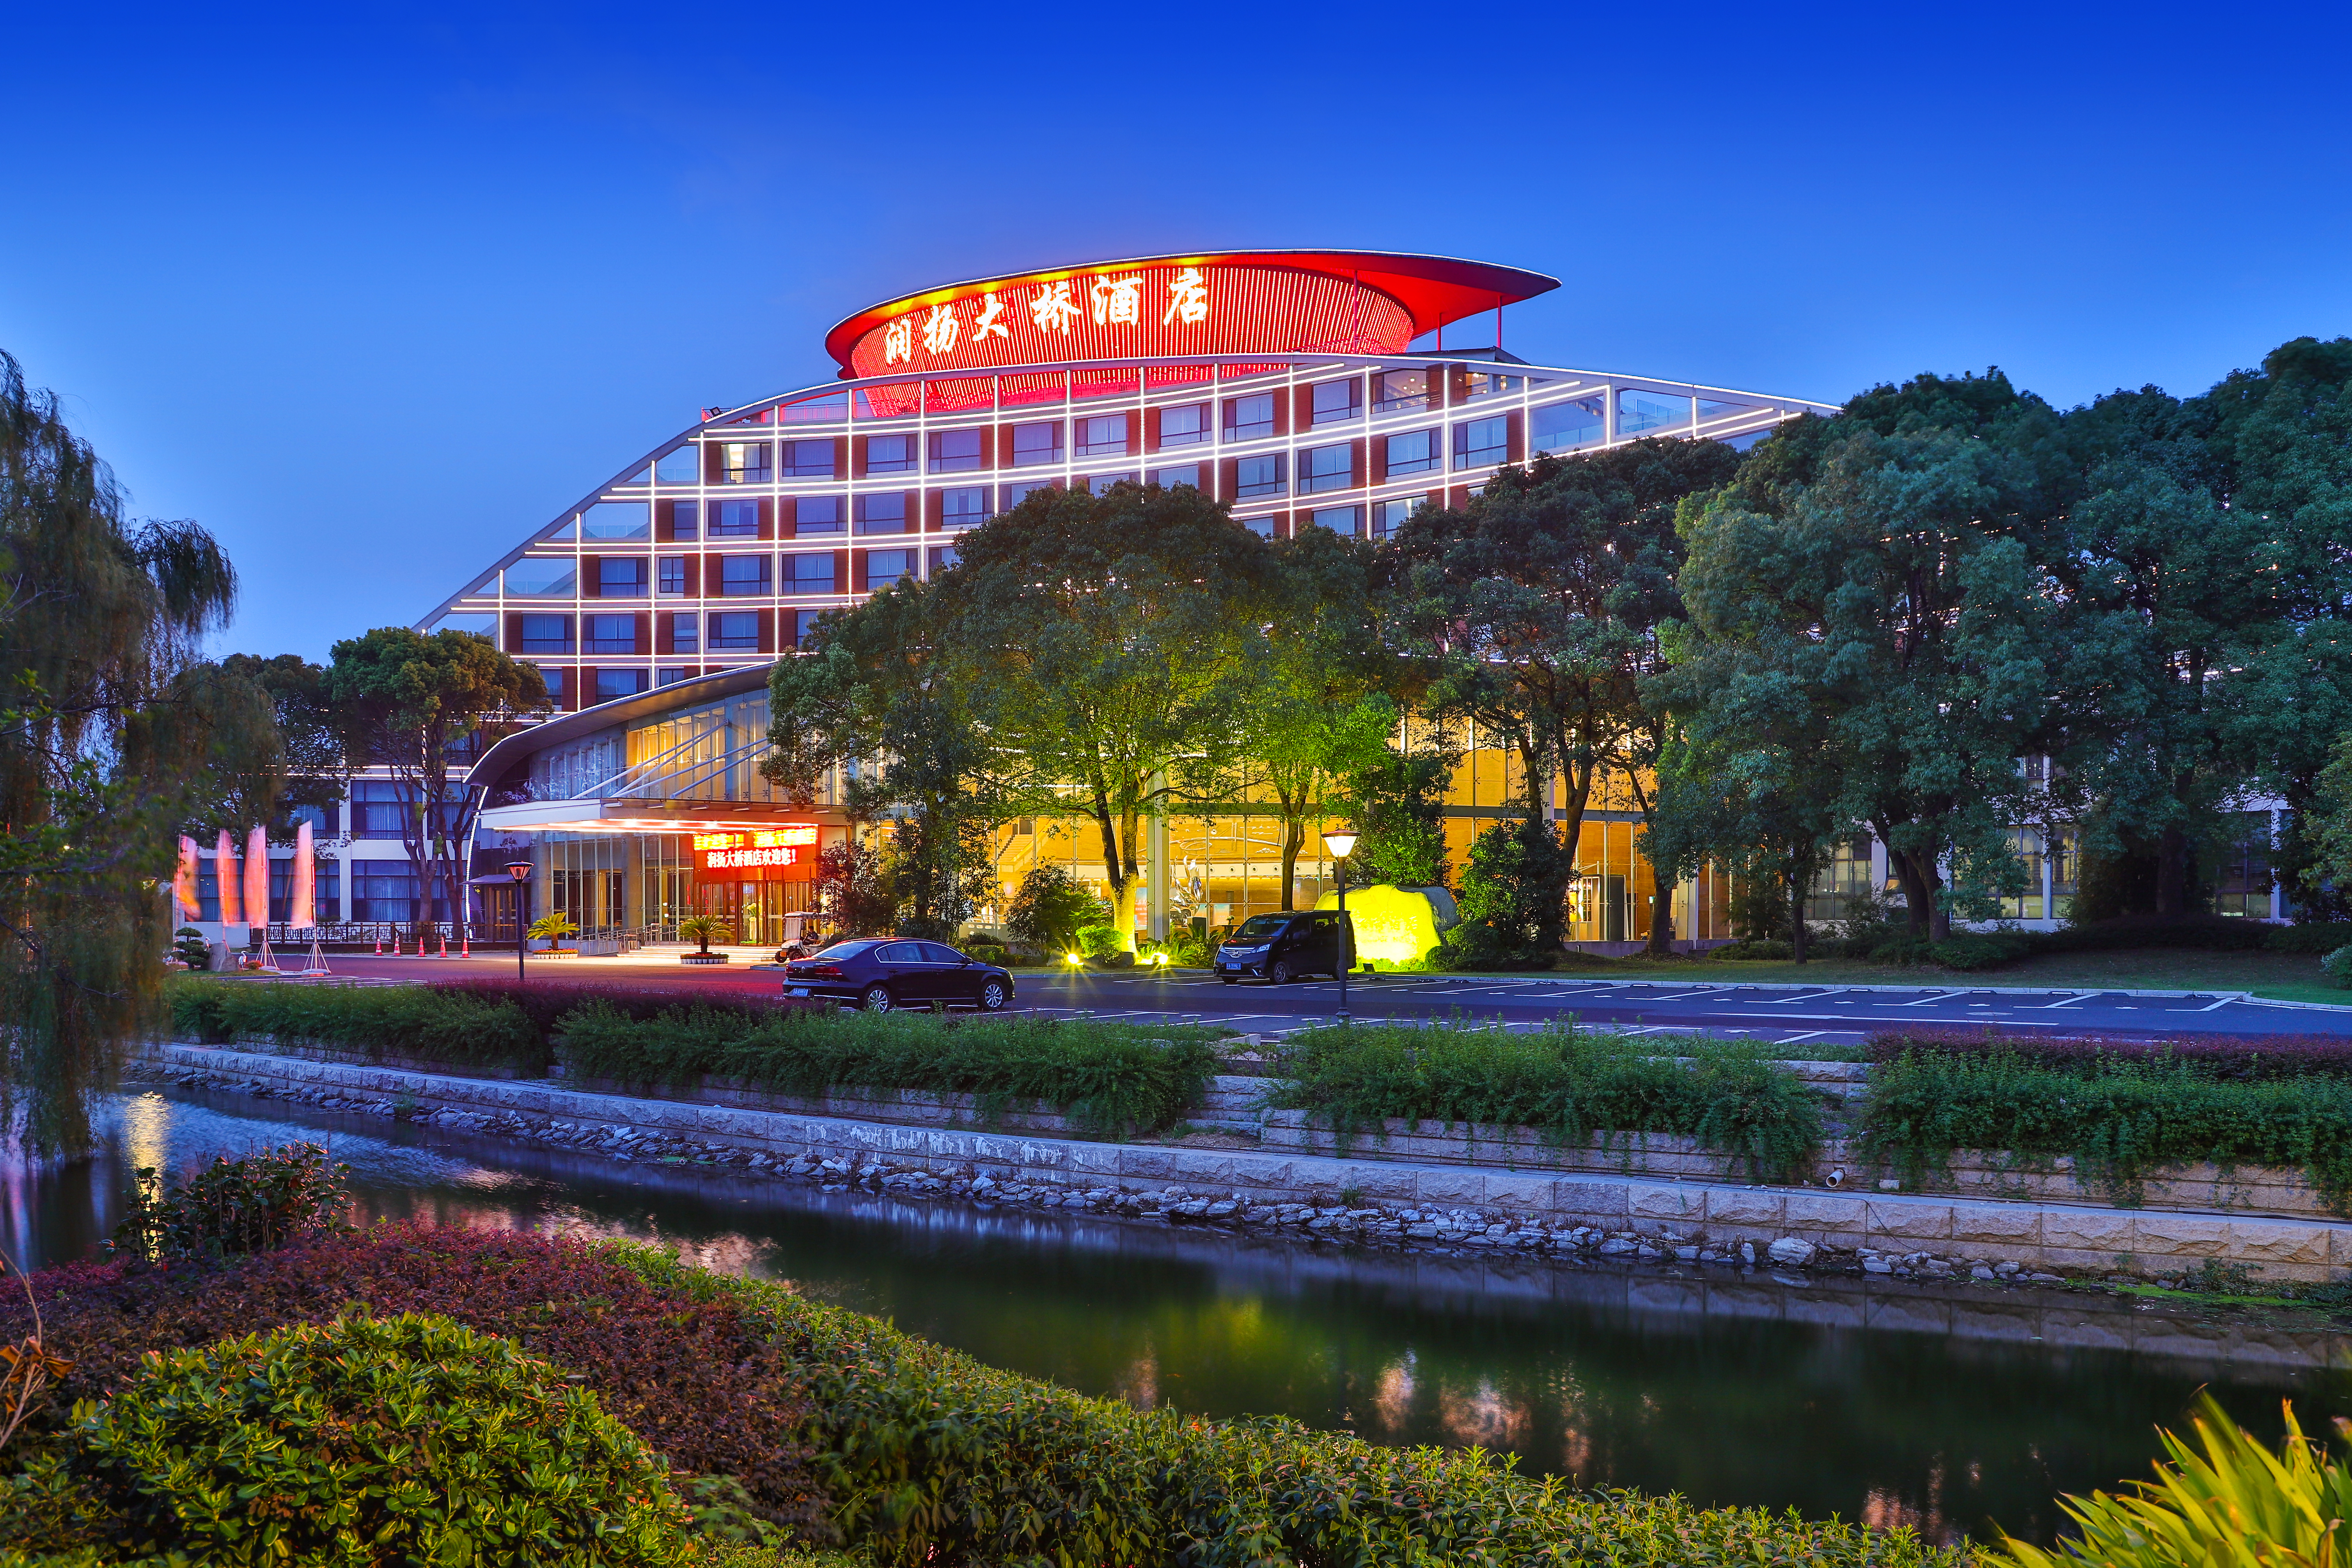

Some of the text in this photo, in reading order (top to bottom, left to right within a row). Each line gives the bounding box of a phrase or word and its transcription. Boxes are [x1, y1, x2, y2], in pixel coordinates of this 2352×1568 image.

[886, 267, 1208, 364] 润扬大桥酒店
